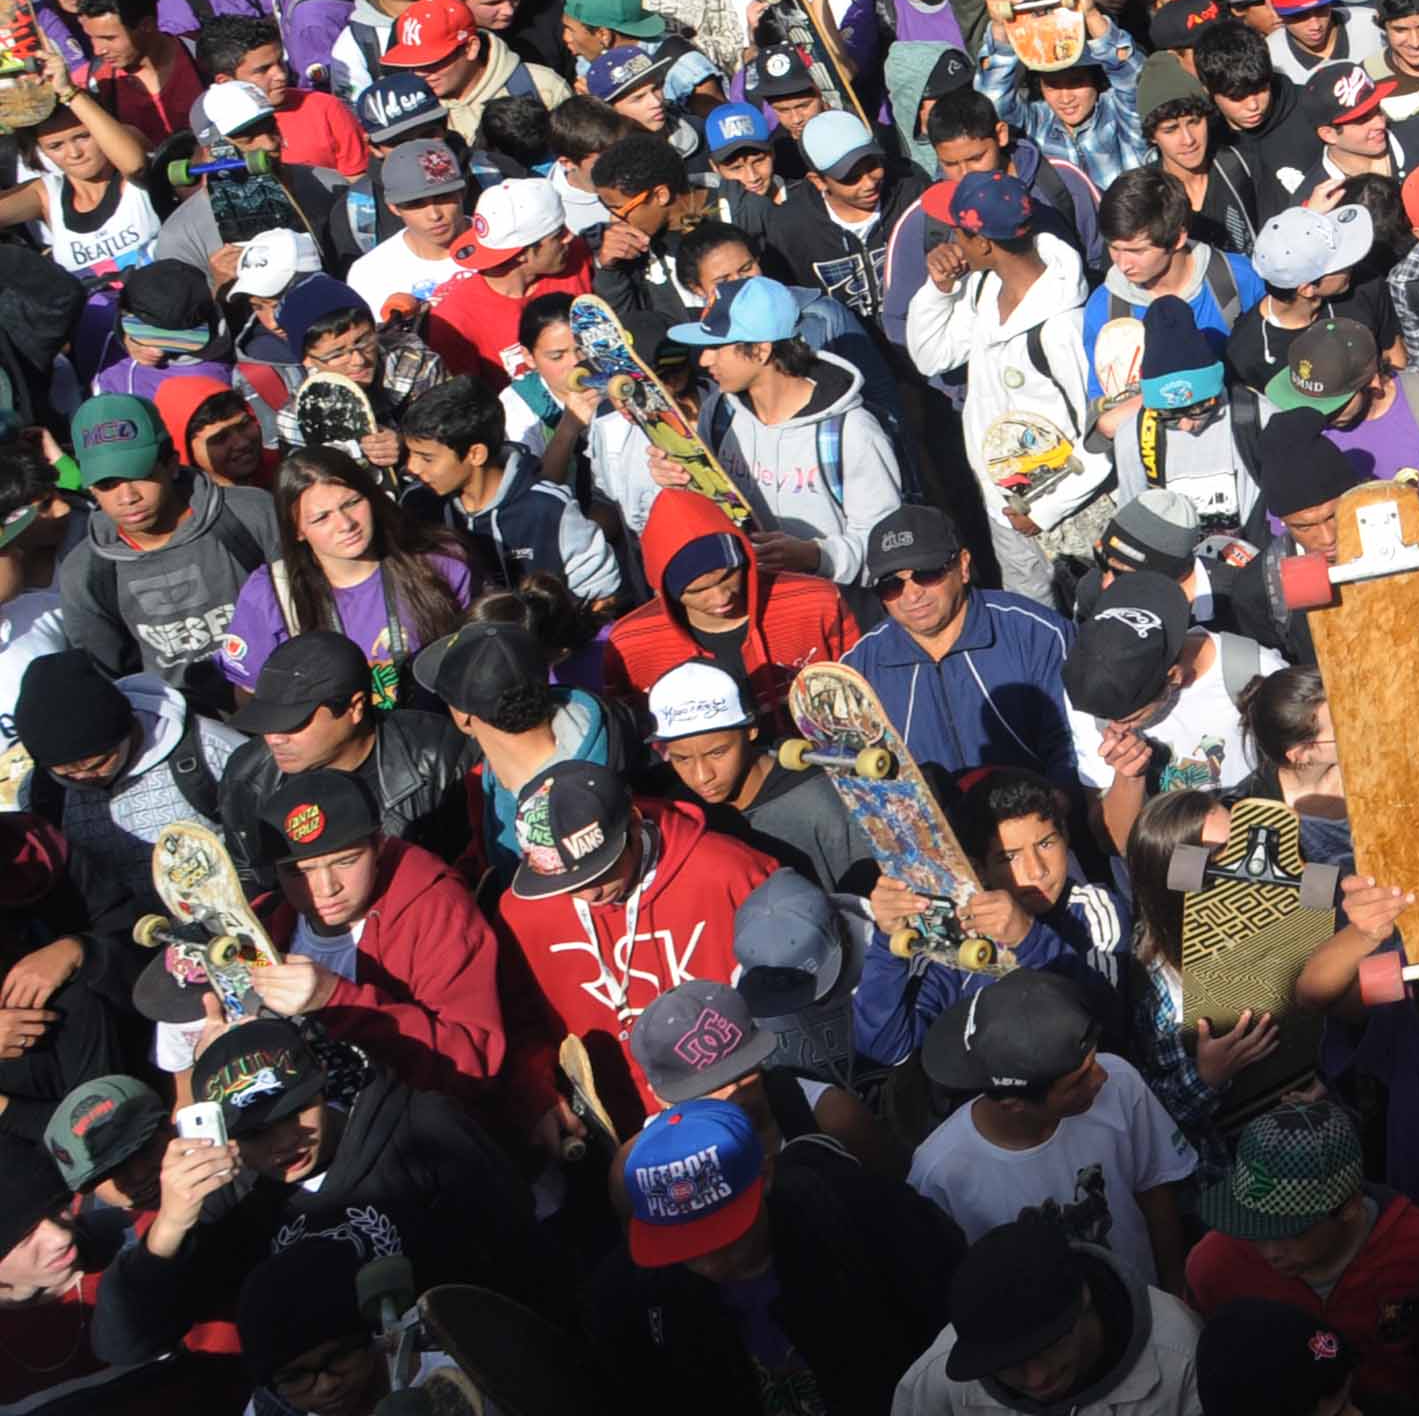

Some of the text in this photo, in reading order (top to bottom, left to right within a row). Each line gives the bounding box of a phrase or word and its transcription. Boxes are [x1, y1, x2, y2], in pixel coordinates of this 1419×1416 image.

[402, 18, 422, 47] NY
[718, 115, 755, 141] VANS
[561, 821, 606, 861] VANS
[635, 1145, 722, 1191] DETROIT
